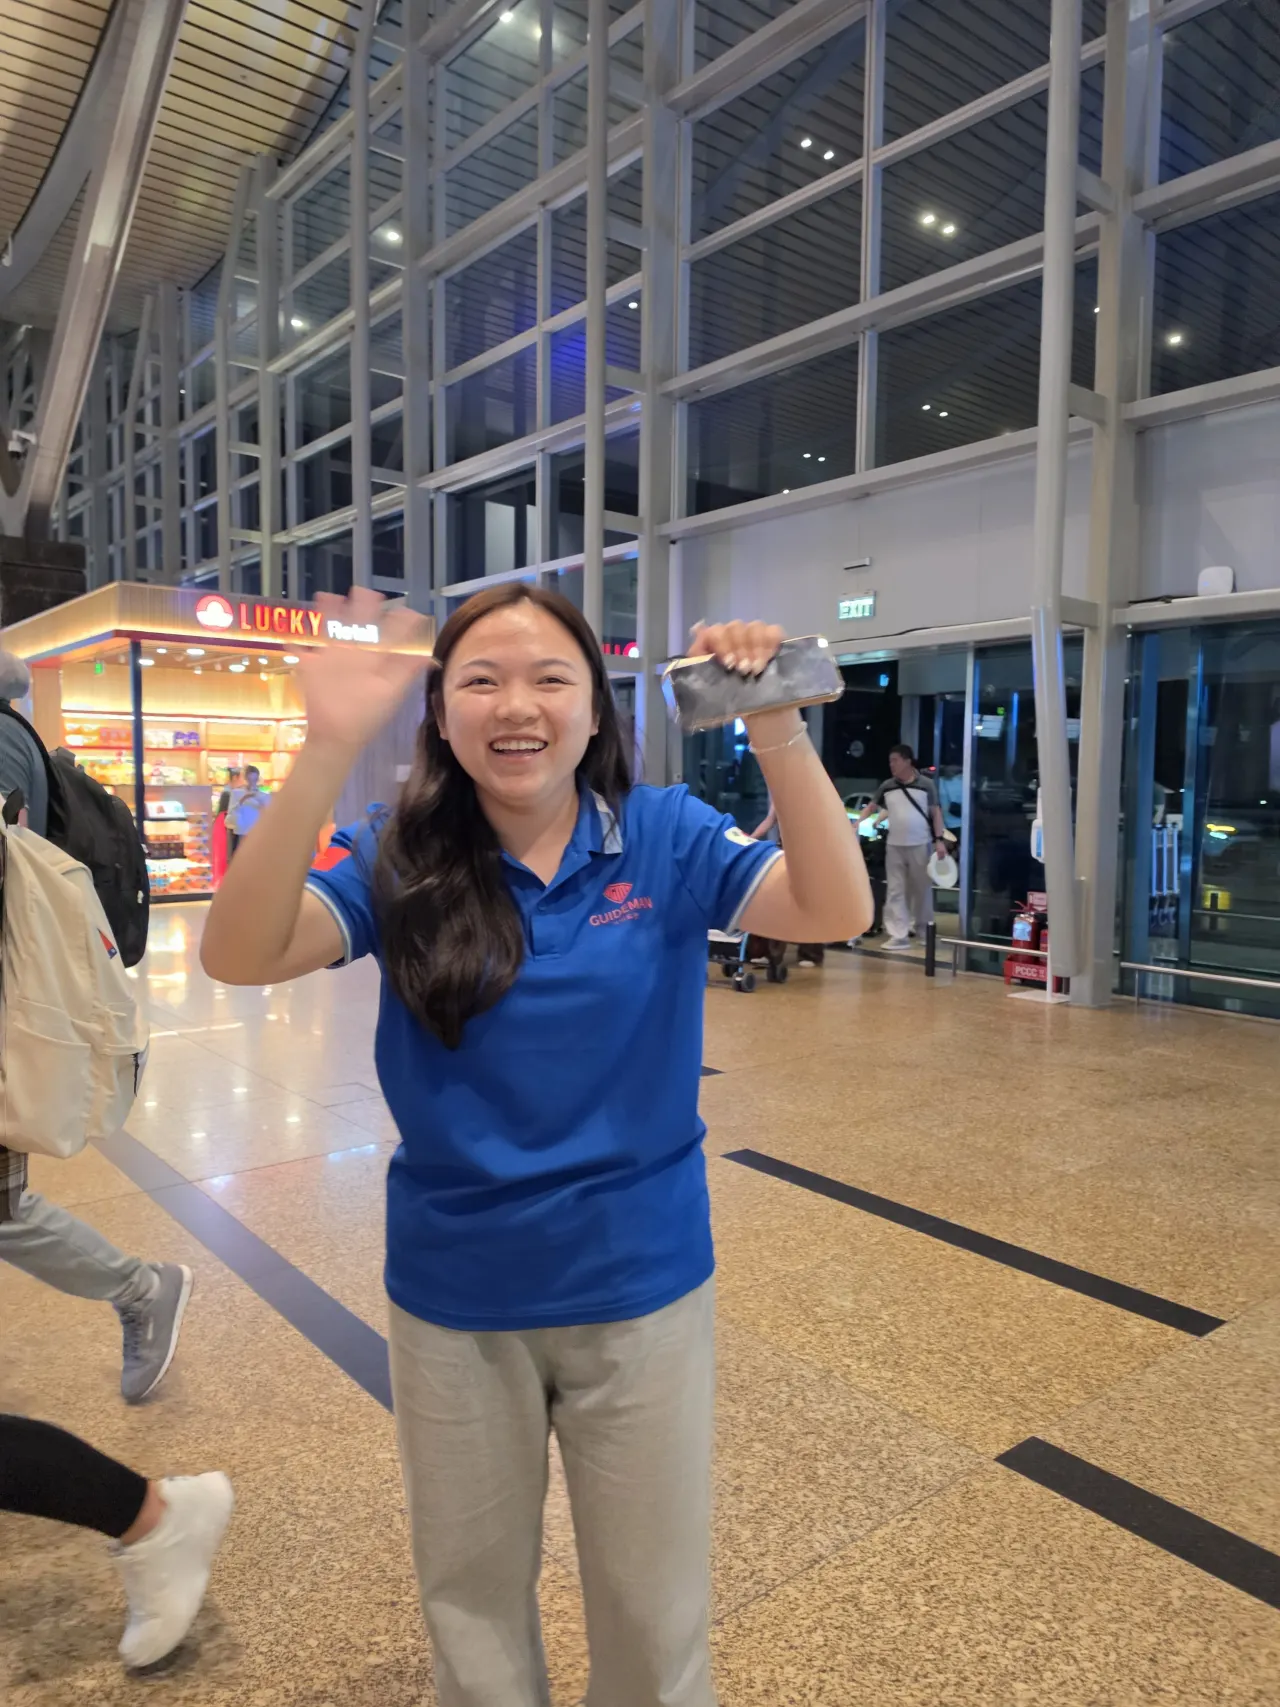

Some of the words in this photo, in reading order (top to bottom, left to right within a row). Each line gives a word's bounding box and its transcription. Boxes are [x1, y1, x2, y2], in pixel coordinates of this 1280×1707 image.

[839, 597, 874, 619] EXIT
[239, 603, 323, 636] LUCKY
[327, 620, 379, 643] Retail
[589, 896, 653, 926] GUIDEMAN
[1015, 965, 1037, 977] PCCC
